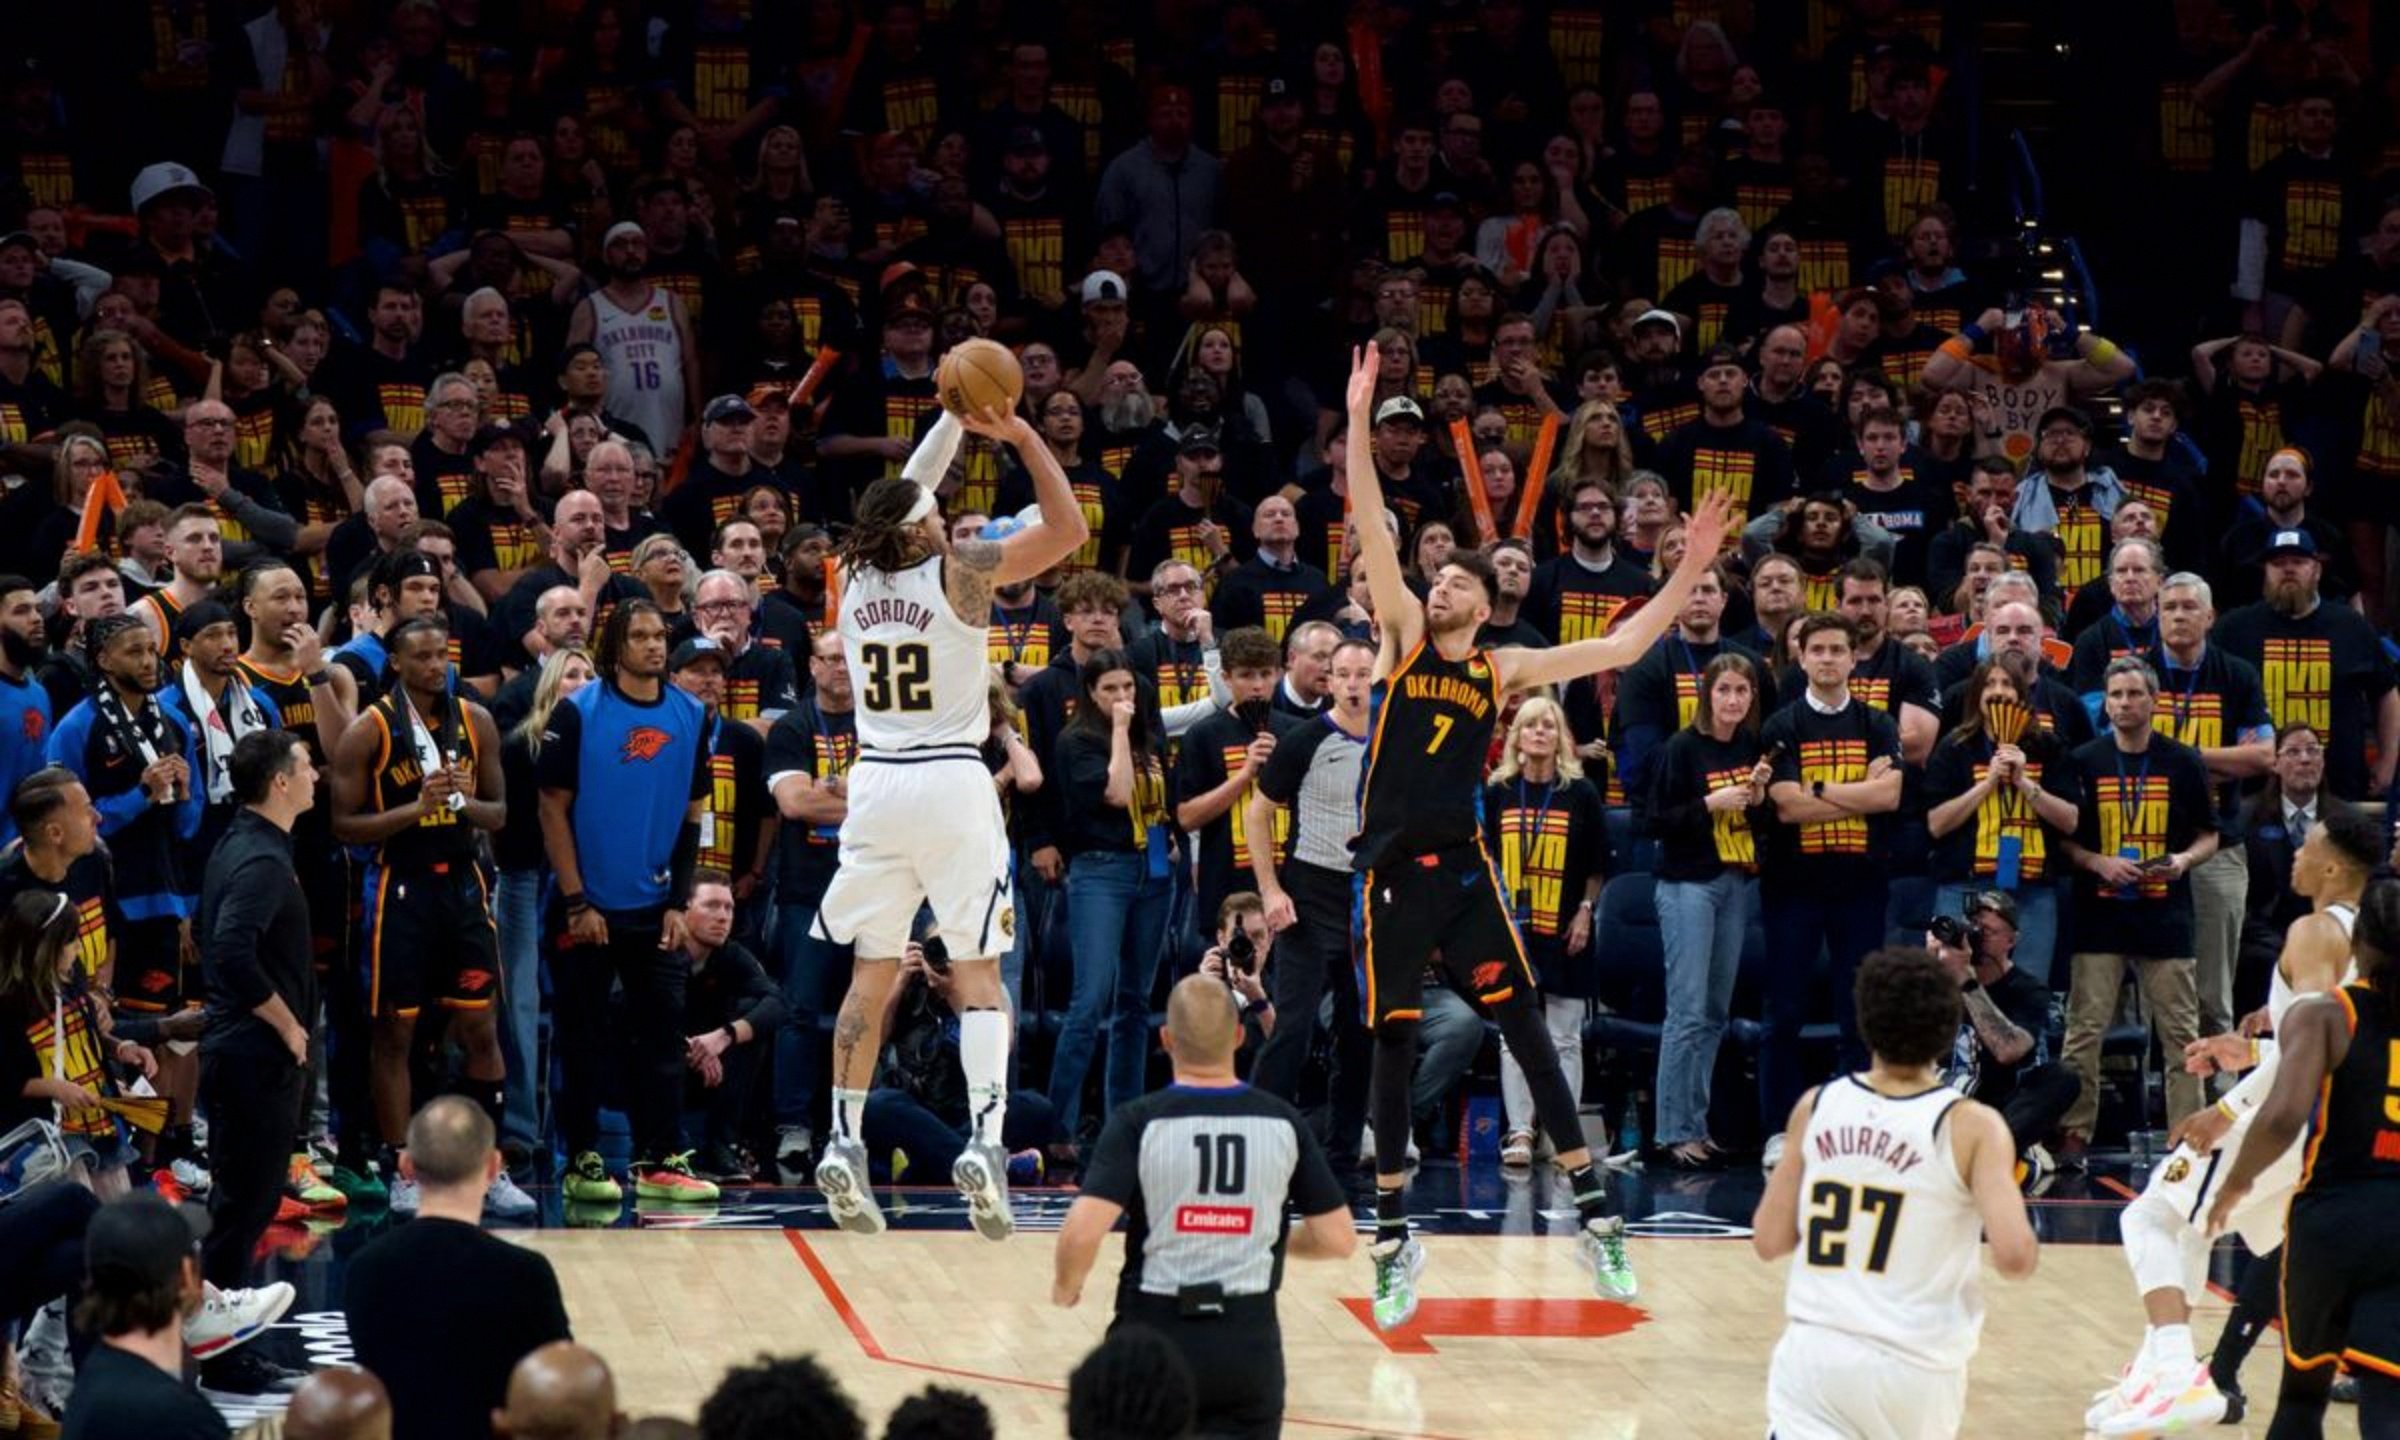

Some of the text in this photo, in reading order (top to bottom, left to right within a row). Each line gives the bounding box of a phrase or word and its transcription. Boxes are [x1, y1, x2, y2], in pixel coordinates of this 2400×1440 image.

[625, 343, 655, 359] CITY
[630, 360, 660, 391] 16
[1985, 383, 2057, 410] BODY
[2006, 412, 2033, 430] BY
[854, 600, 933, 632] GORDON
[862, 643, 933, 713] 32
[1404, 674, 1488, 719] OKLAHOMA
[1426, 714, 1455, 755] 7
[1193, 1133, 1246, 1196] 10
[1816, 1125, 1924, 1174] MURRAY
[1183, 1210, 1245, 1228] Emirates
[1807, 1180, 1907, 1273] 27
